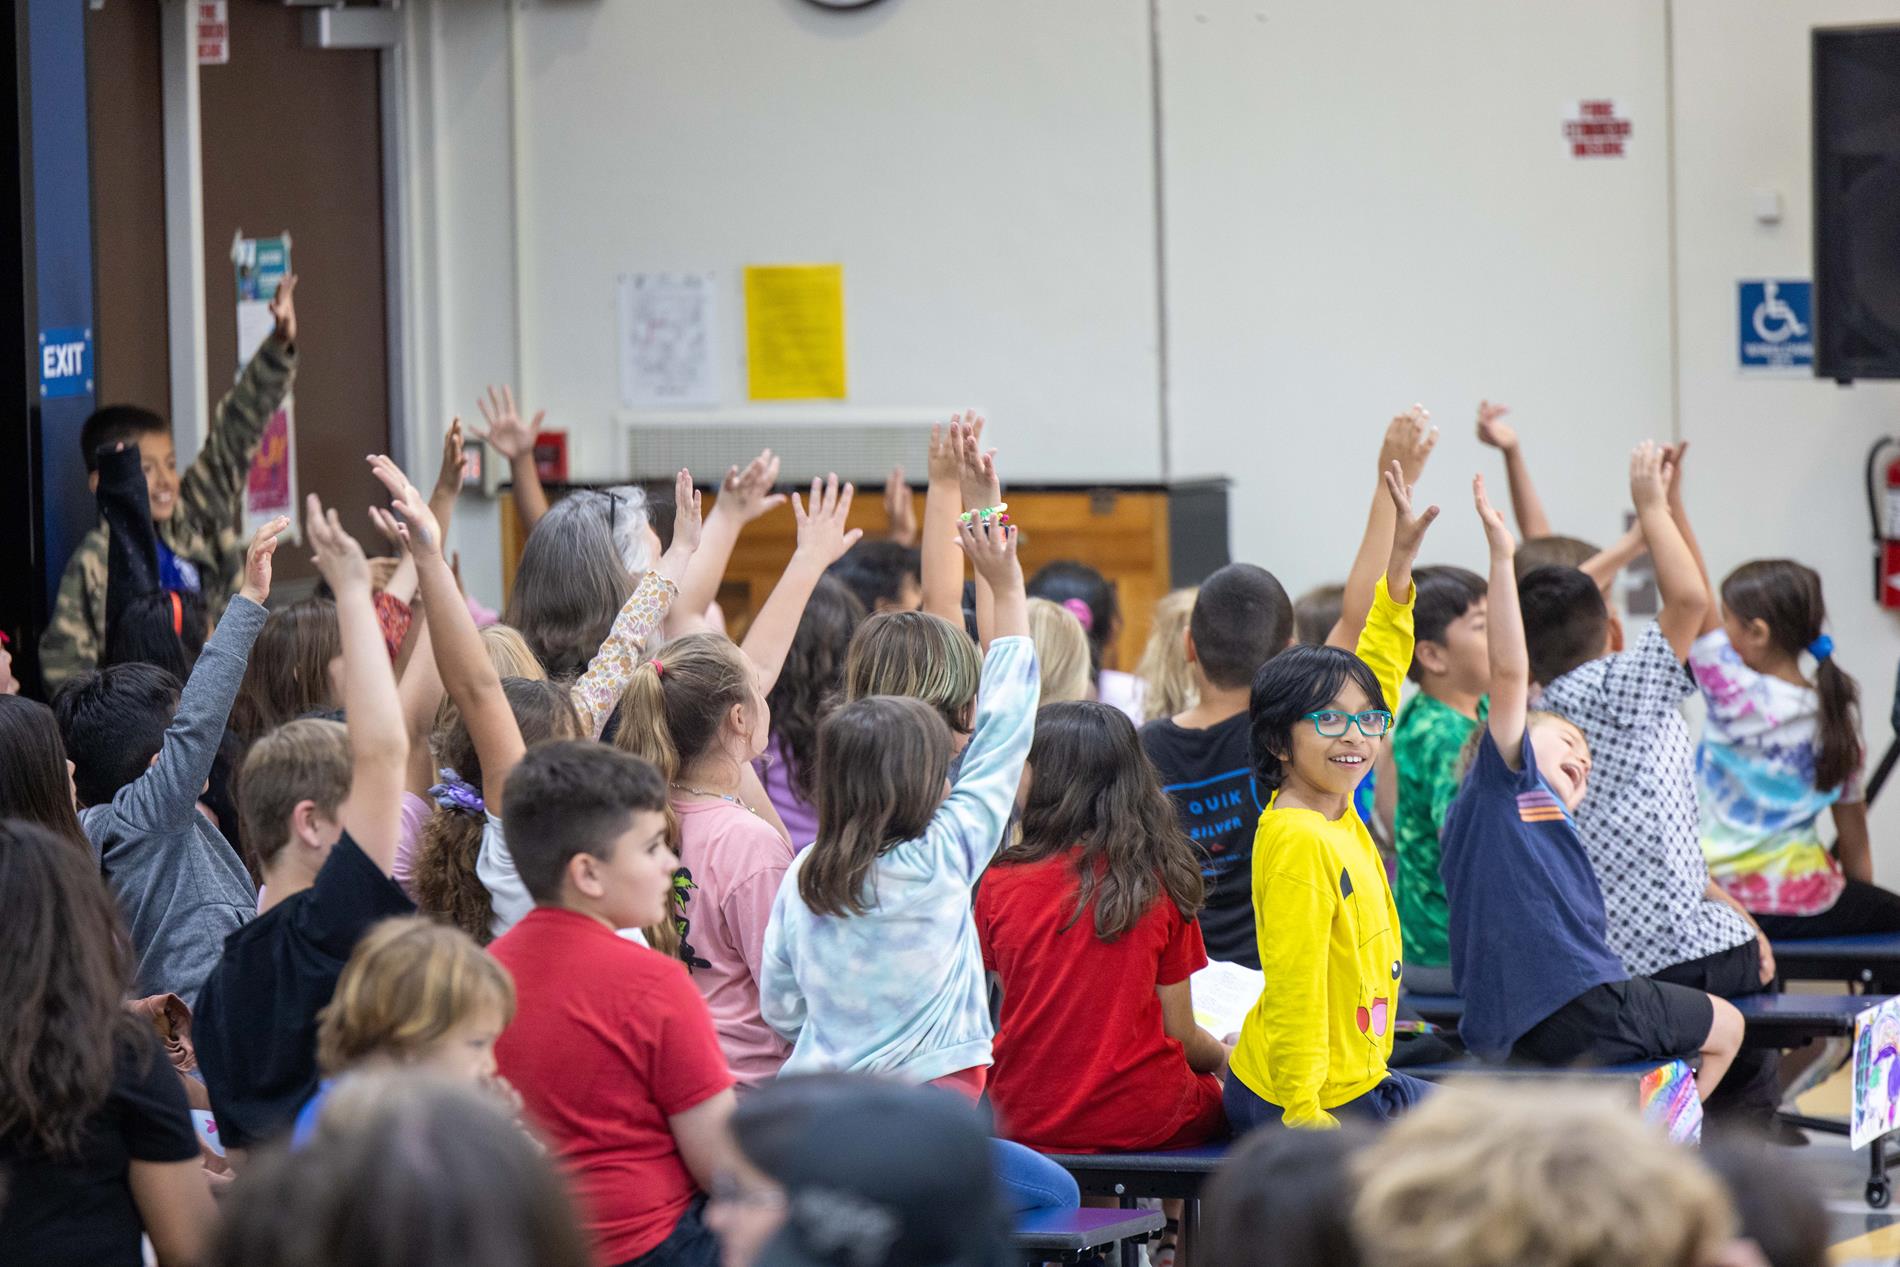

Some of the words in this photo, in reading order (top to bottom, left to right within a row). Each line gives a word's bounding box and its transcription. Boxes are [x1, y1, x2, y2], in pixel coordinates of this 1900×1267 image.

[43, 342, 85, 378] EXIT
[1189, 790, 1241, 815] QUIK
[1190, 816, 1242, 839] SILVER
